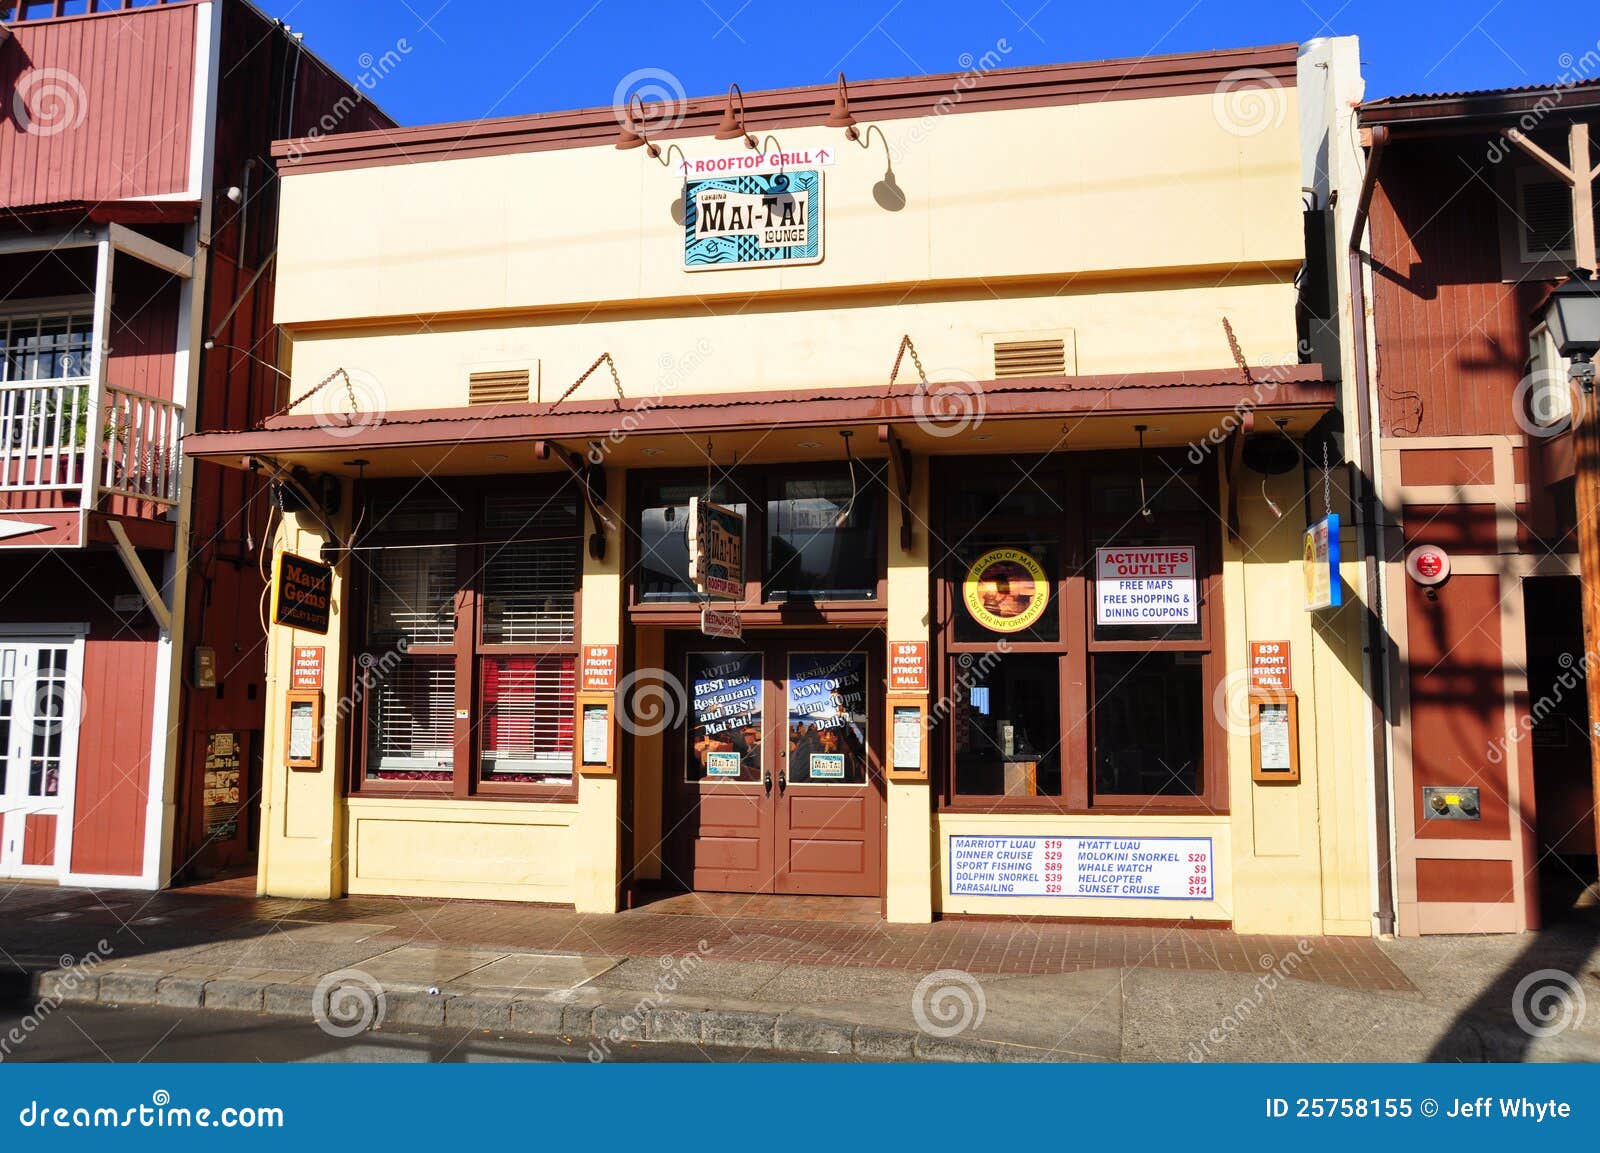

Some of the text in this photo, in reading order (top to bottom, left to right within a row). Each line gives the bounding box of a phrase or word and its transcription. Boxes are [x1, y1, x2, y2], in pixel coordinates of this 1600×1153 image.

[695, 151, 812, 172] ROOFTOP GRILL
[700, 197, 805, 233] MAI-TAI
[764, 228, 805, 244] LOUNGE
[1105, 552, 1189, 564] ACTIVITIES
[973, 552, 1002, 576] ISLAND
[1019, 555, 1039, 575] MAUI
[1117, 564, 1177, 575] OUTLET
[287, 564, 326, 591] Maui
[1119, 580, 1173, 590] FREE MAPS
[285, 582, 326, 609] Gems
[1103, 594, 1190, 604] FREE SHOPPING &
[968, 592, 1044, 627] VISITOR INFORMATION
[1105, 607, 1189, 618] DINING COUPONS
[301, 650, 317, 658] 839
[591, 648, 608, 656] 839
[898, 646, 917, 654] 839
[1259, 645, 1280, 654] 839
[702, 660, 741, 679] VOTED
[1254, 667, 1287, 675] STREET
[694, 674, 751, 696] BEST new
[793, 672, 860, 700] NOW OPEN
[1259, 677, 1283, 685] MALL
[693, 685, 757, 711] Restaurant
[797, 703, 824, 717] 11am
[830, 691, 861, 708] 10pm
[700, 700, 755, 723] and BEST
[704, 714, 753, 735] Mai Tai!
[956, 840, 1062, 849] MARRIOTT LUAU $19
[1078, 841, 1140, 850] HYATT LUAU
[956, 851, 1062, 860] DINNER CRUISE $29
[1078, 852, 1206, 862] MOLOKINI SNORKEL $20
[956, 861, 1062, 871] SPORT FISHING $89
[1078, 863, 1206, 874] WHALE WATCH $9
[956, 872, 1062, 882] DOLPHIN SNORKEL $39
[1078, 874, 1207, 885] HELICOPTER $89
[956, 883, 1061, 893] PARASAILING $29
[1078, 885, 1207, 896] SUNSET CRUISE $14
